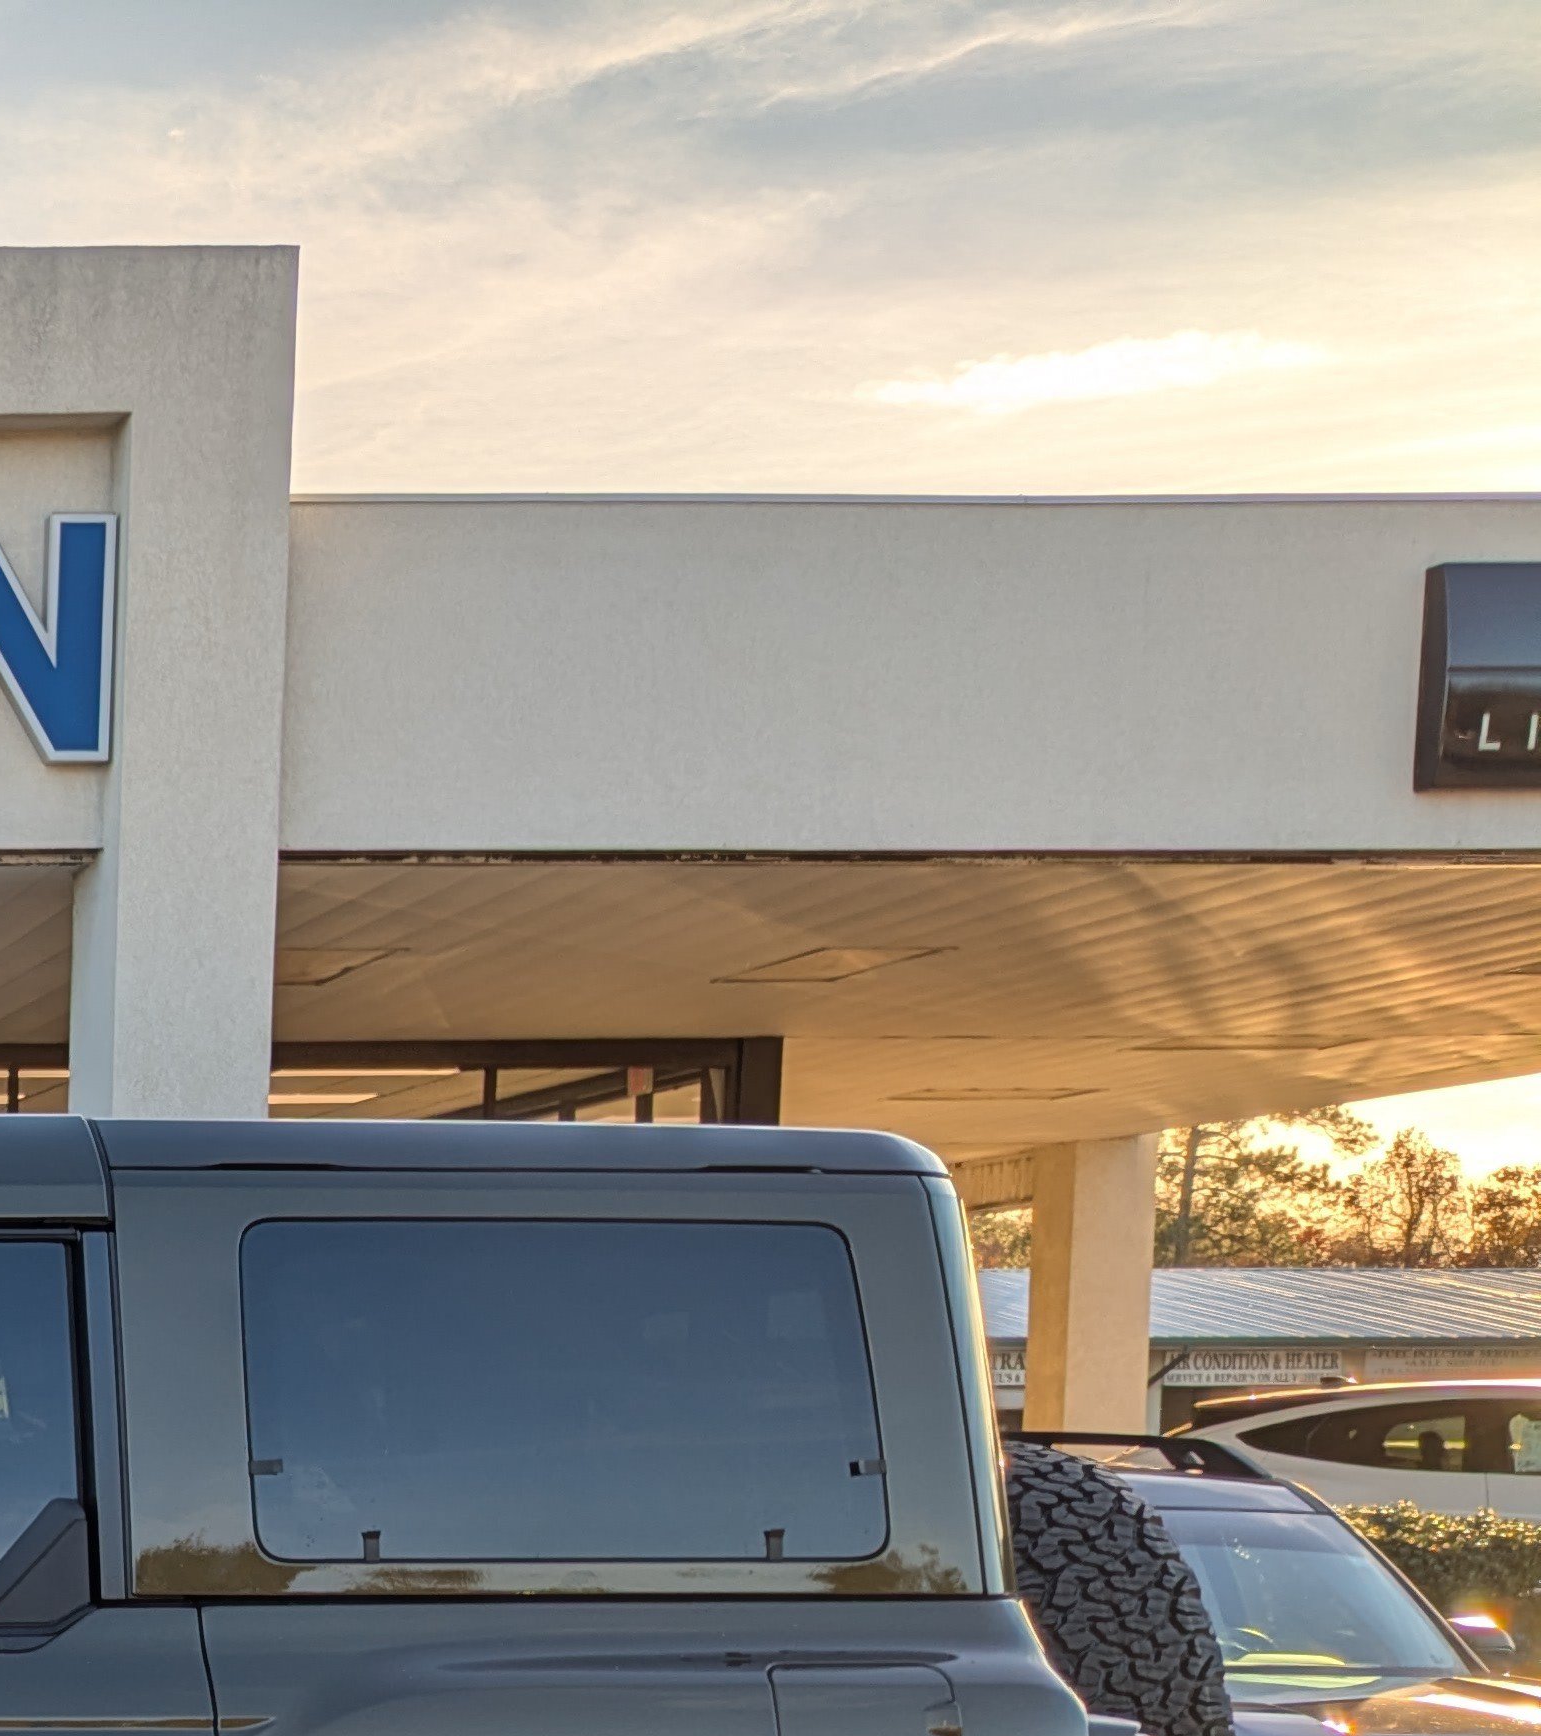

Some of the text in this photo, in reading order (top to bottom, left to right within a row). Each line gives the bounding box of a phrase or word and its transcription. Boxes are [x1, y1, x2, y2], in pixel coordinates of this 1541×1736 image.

[1193, 1352, 1270, 1370] CONDITION
[1272, 1352, 1281, 1370] &
[1284, 1352, 1339, 1370] HEATER
